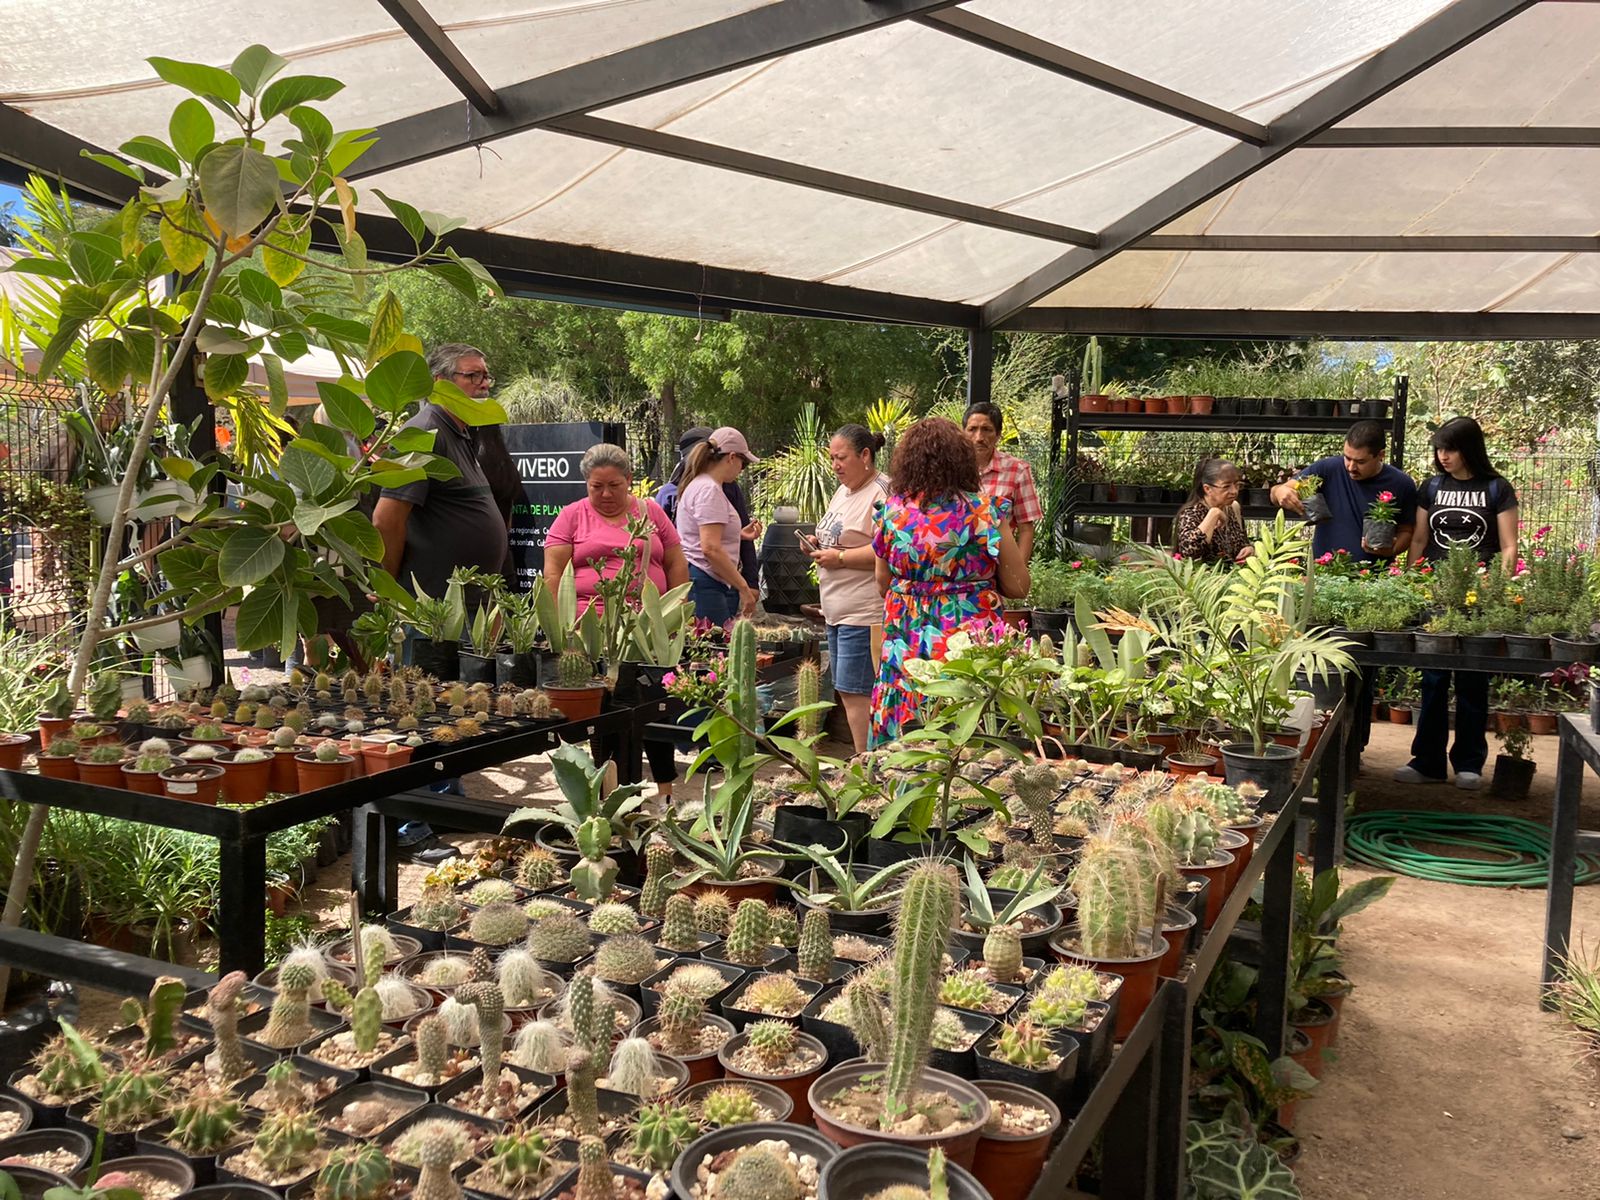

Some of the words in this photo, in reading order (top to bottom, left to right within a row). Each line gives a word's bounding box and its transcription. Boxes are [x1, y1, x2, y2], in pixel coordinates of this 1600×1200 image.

[1434, 490, 1486, 507] NIRVANA
[530, 504, 541, 515] DE
[516, 526, 540, 536] regionales
[517, 538, 534, 547] sombra
[517, 568, 537, 577] LUNES
